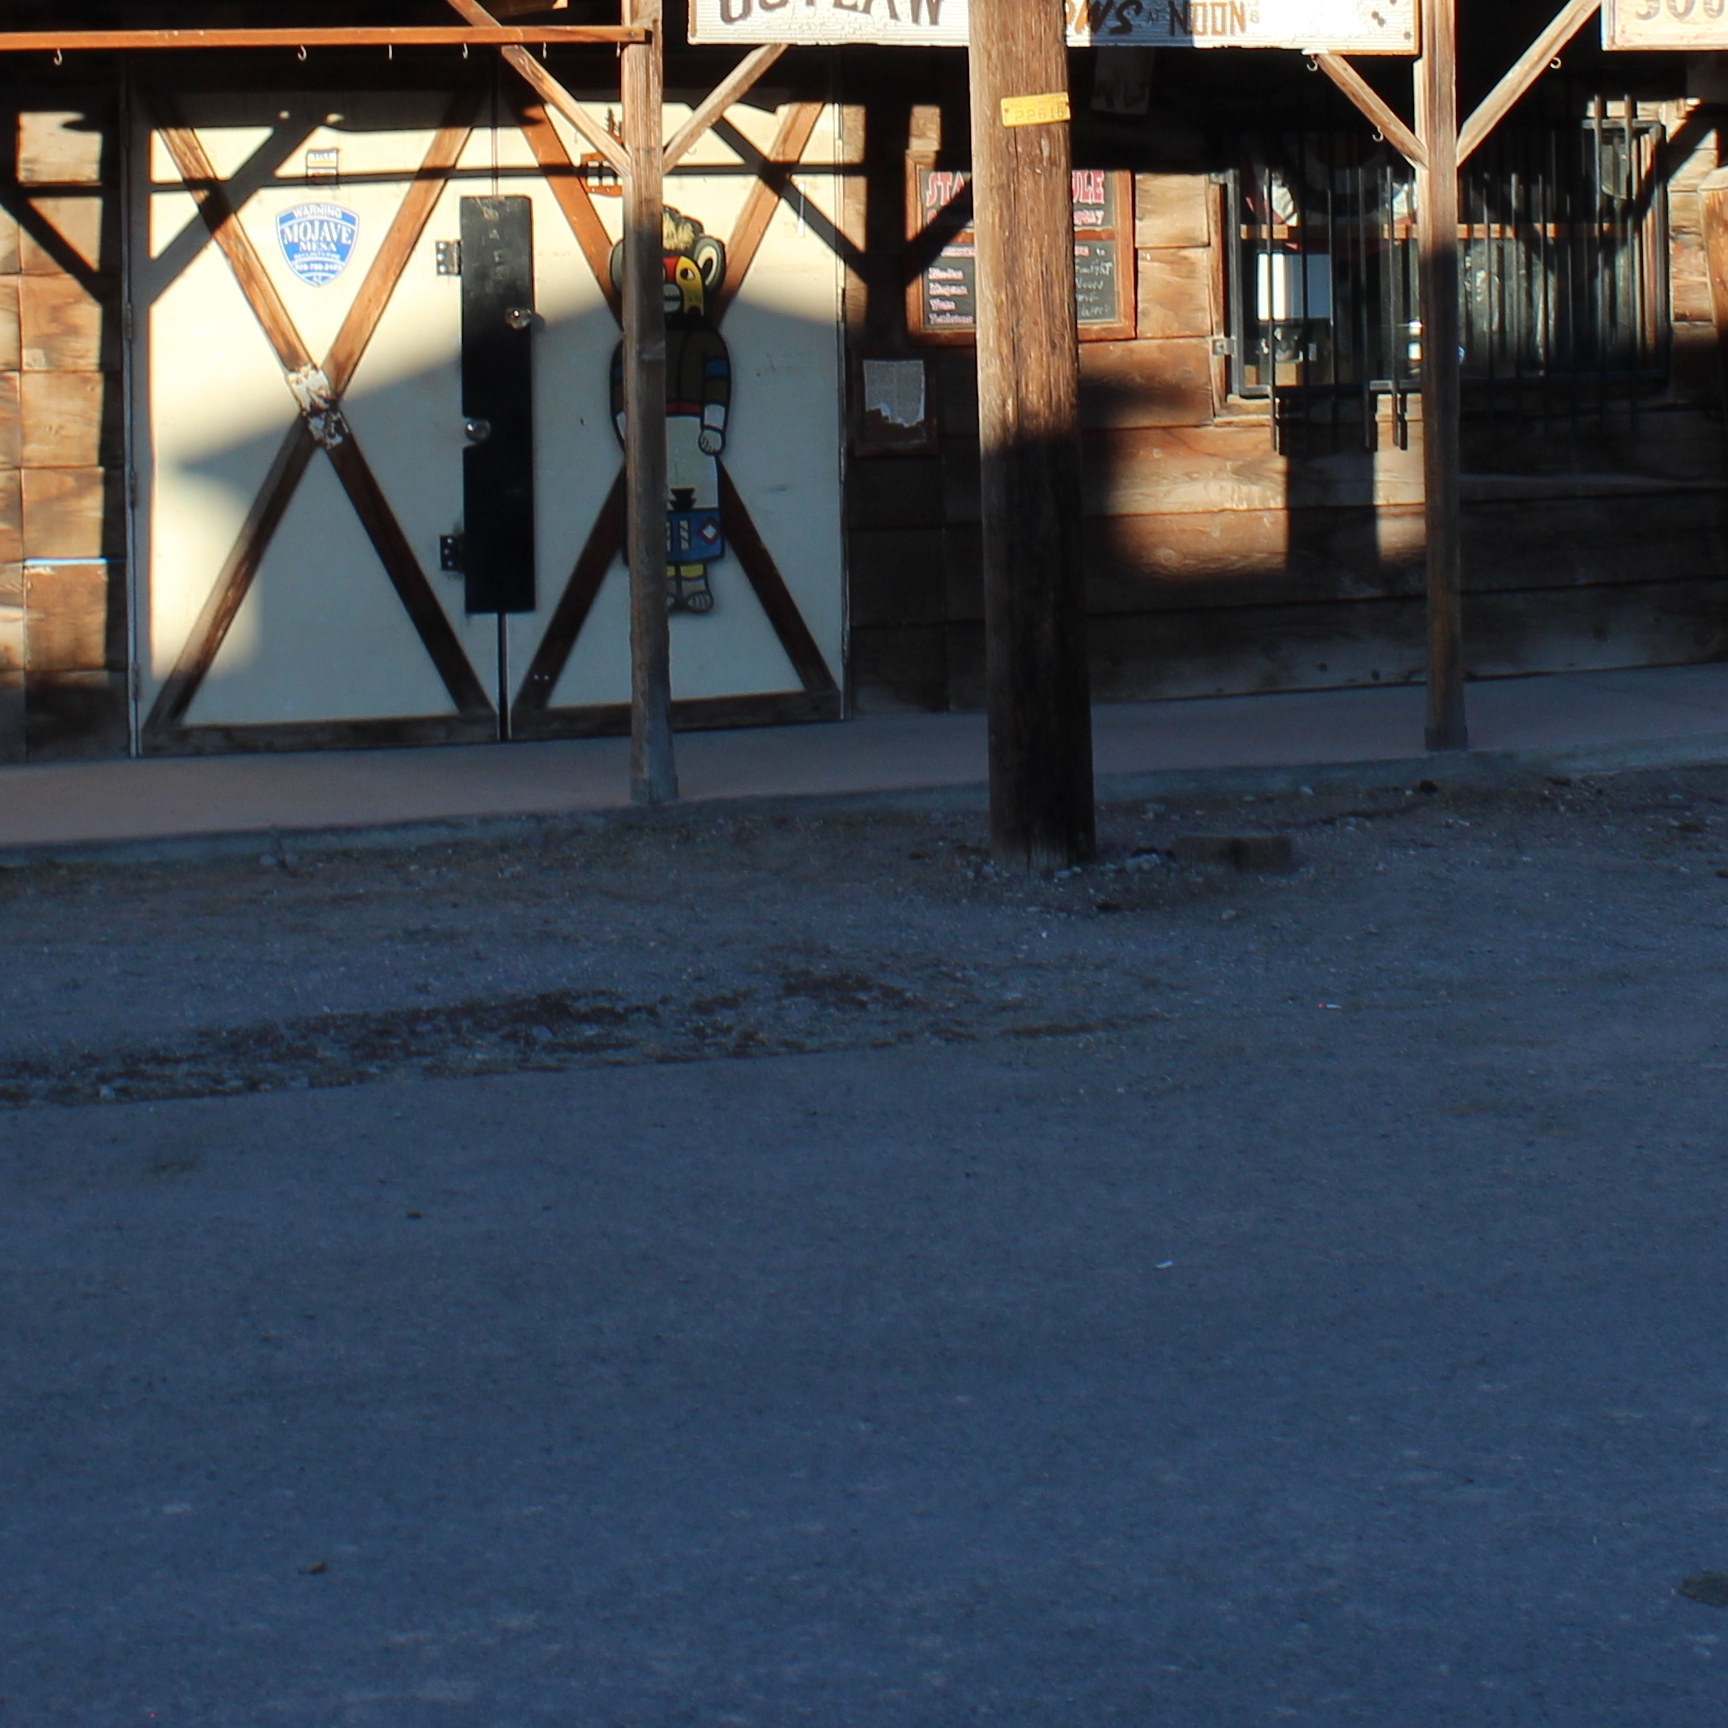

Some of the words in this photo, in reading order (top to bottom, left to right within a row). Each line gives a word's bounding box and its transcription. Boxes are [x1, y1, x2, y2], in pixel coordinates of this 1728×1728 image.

[293, 204, 343, 220] WARNING
[283, 220, 352, 245] MOJAVE
[299, 241, 337, 252] MESA
